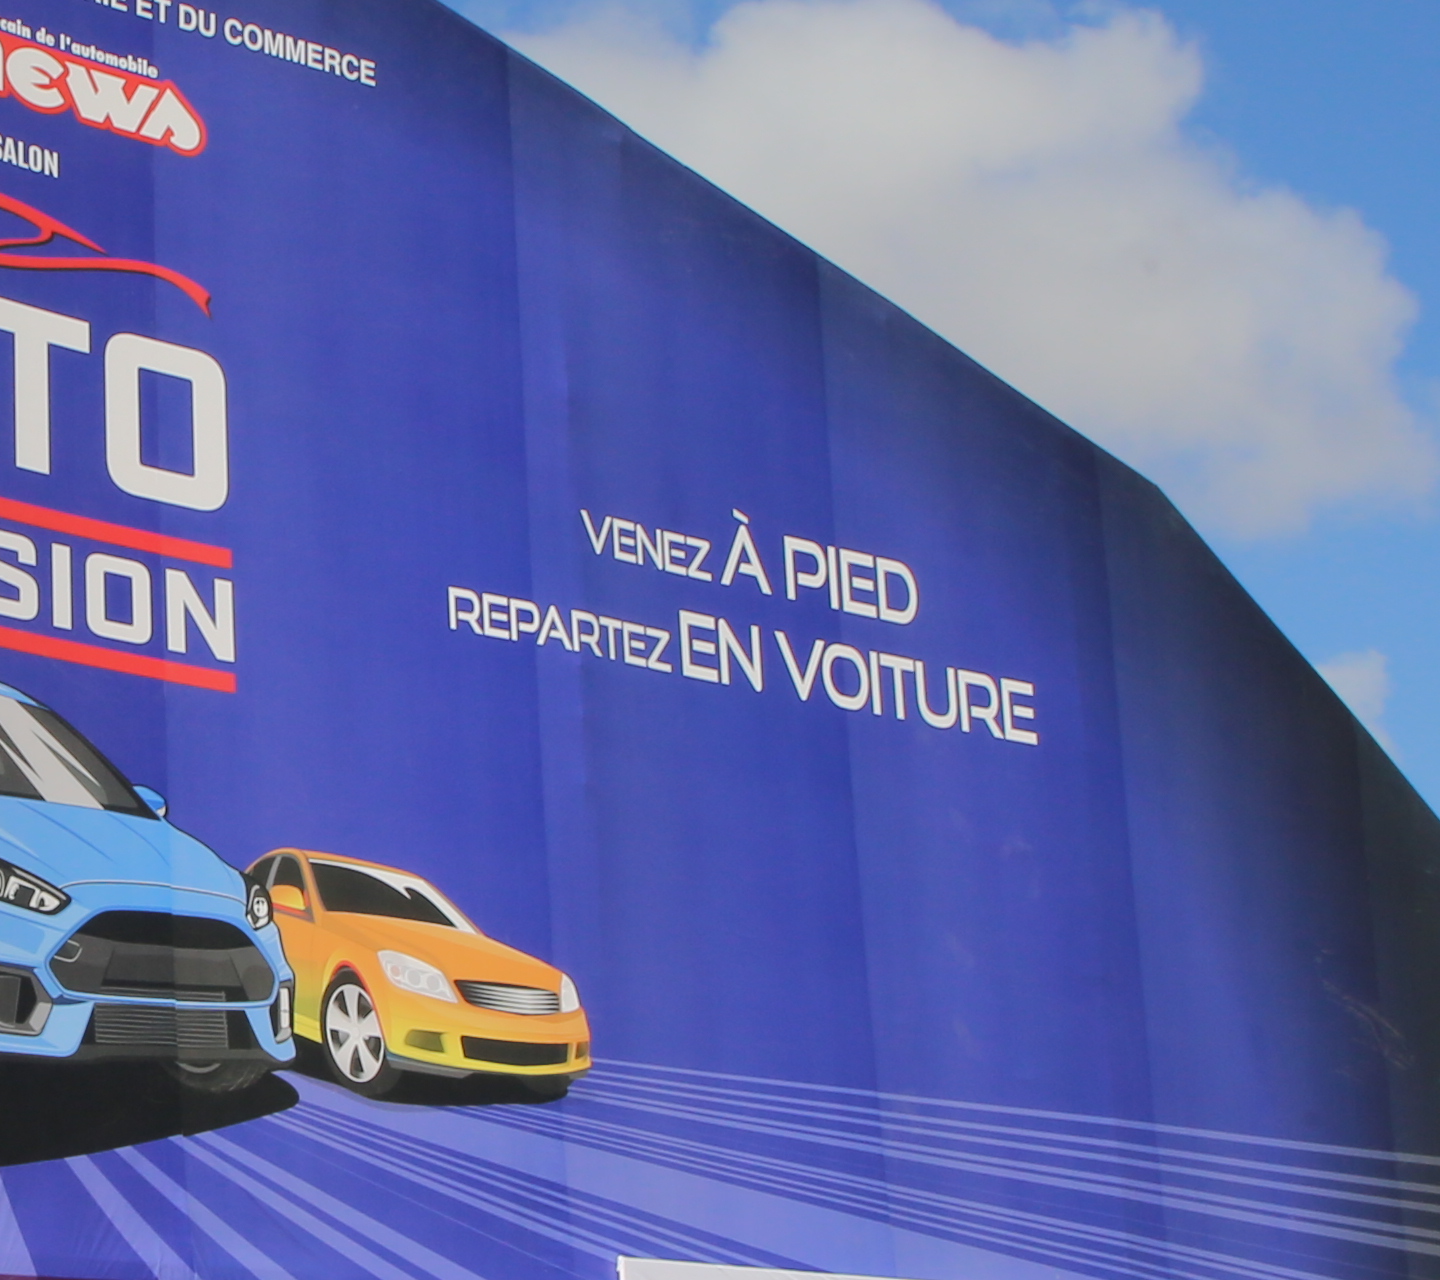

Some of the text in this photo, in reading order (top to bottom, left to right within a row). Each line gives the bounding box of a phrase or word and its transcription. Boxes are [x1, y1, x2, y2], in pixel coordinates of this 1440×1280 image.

[35, 27, 55, 48] de
[59, 35, 159, 79] l'automobile
[178, 3, 216, 38] DU
[223, 18, 378, 87] COMMERCE
[580, 508, 919, 626] VENEZ À PIED
[447, 585, 1039, 746] REPARTEZ EN VOITURE
